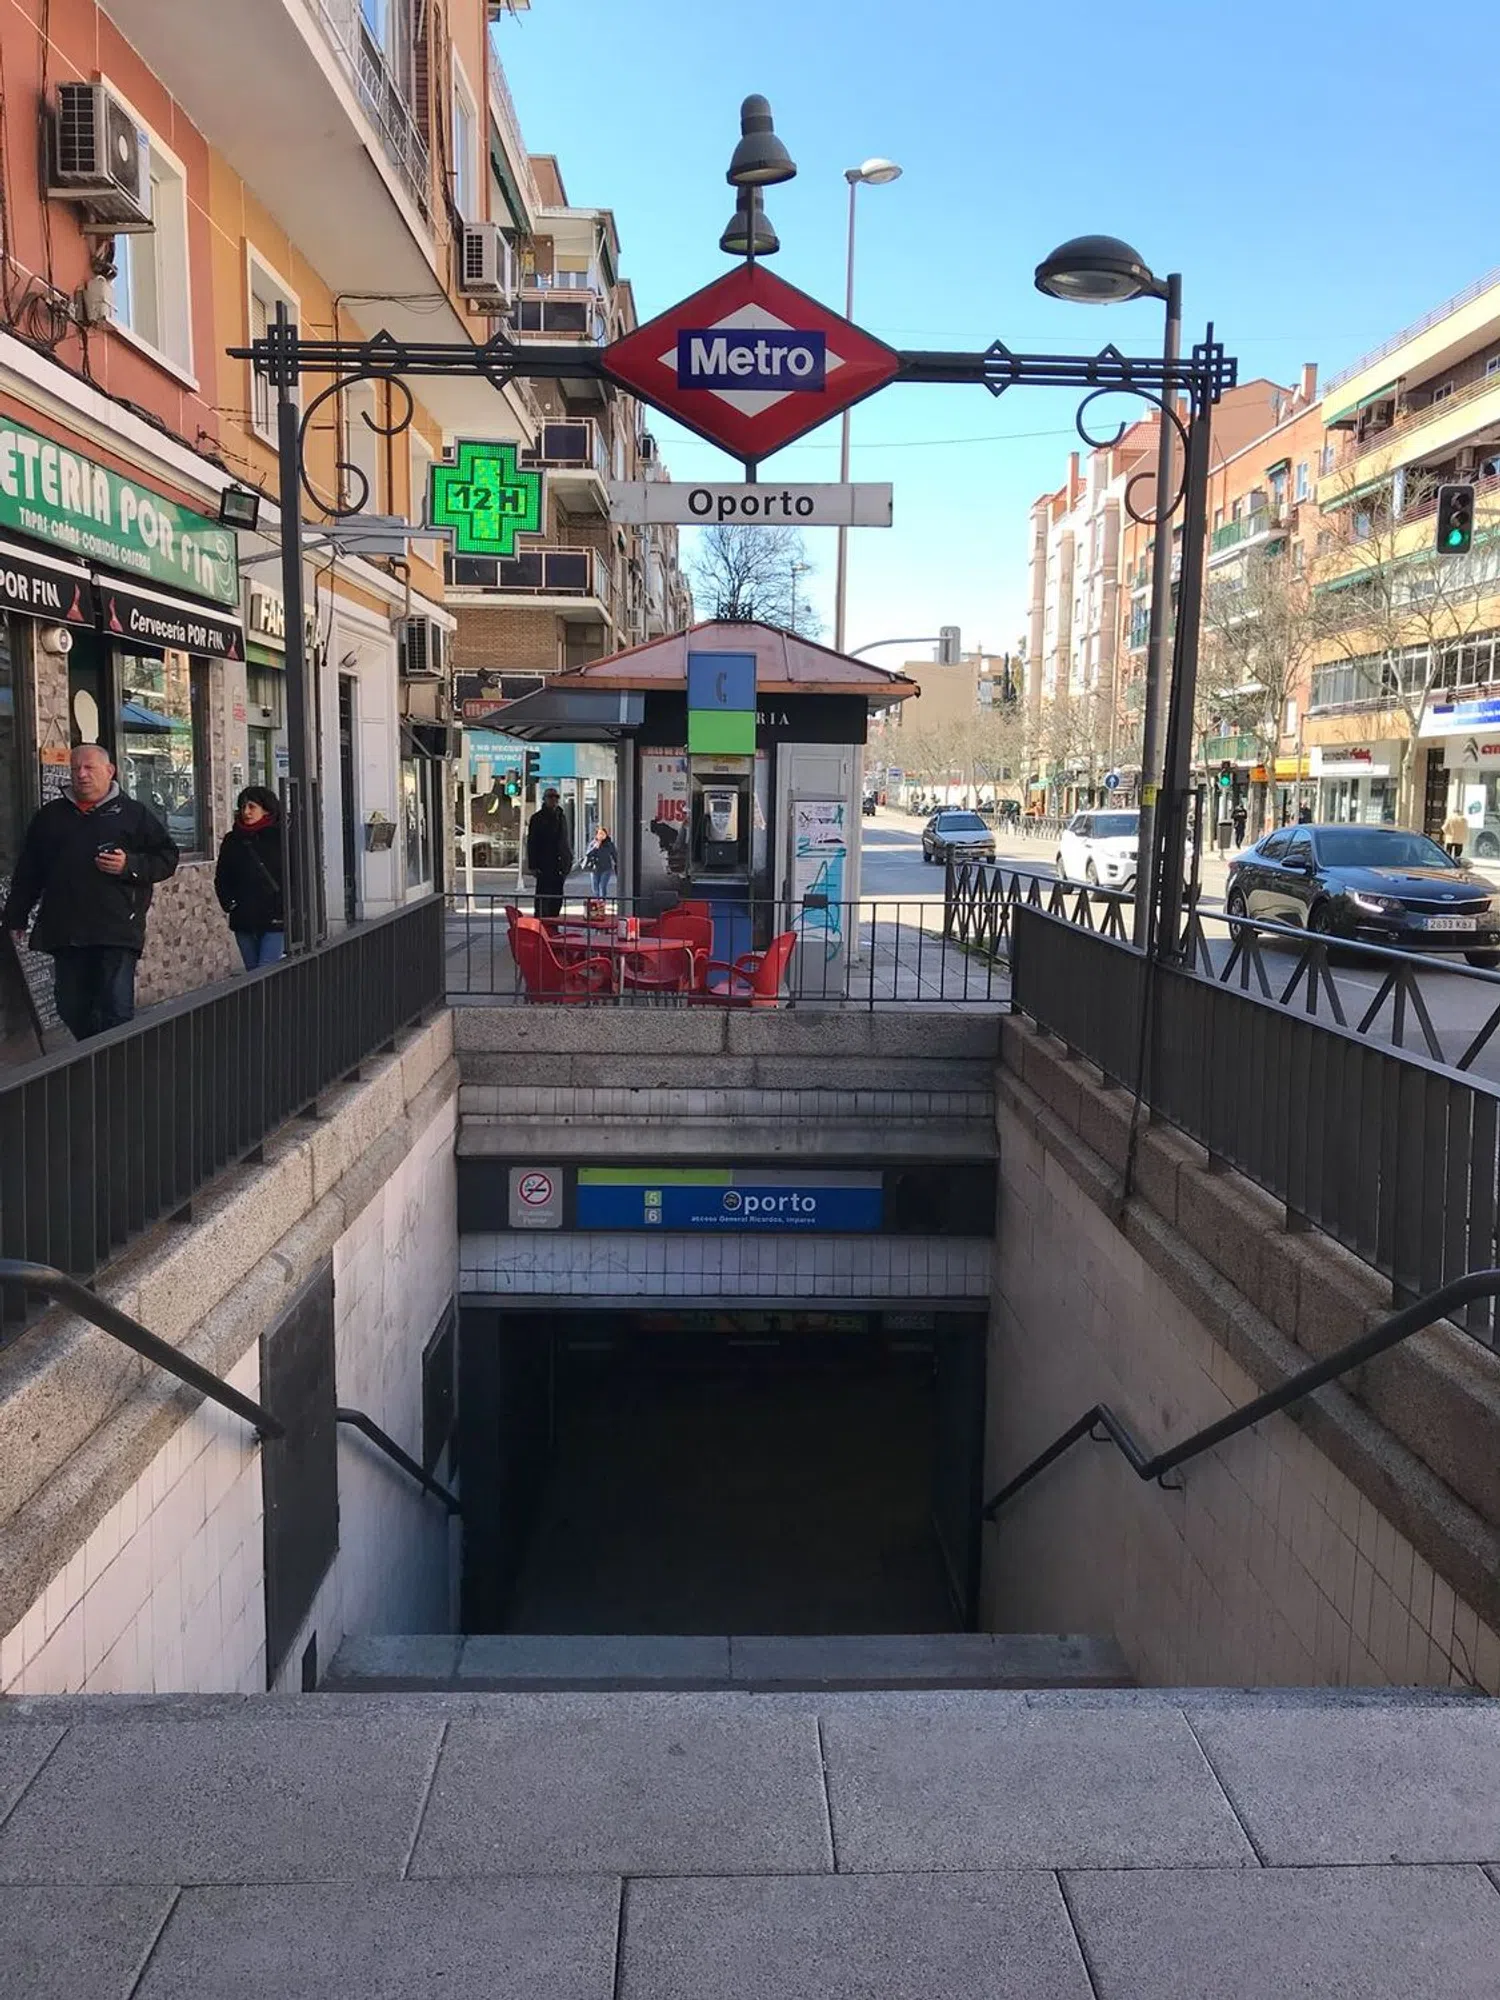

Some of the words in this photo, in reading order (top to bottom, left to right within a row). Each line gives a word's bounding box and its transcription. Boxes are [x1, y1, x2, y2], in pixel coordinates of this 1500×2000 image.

[690, 337, 815, 376] Metro
[454, 486, 493, 511] 12
[500, 488, 519, 512] H
[688, 489, 815, 520] Oporto
[120, 485, 175, 563] POR
[32, 577, 62, 608] FIN
[130, 607, 186, 643] Cervecería
[187, 623, 206, 648] POR
[207, 628, 226, 651] FIN
